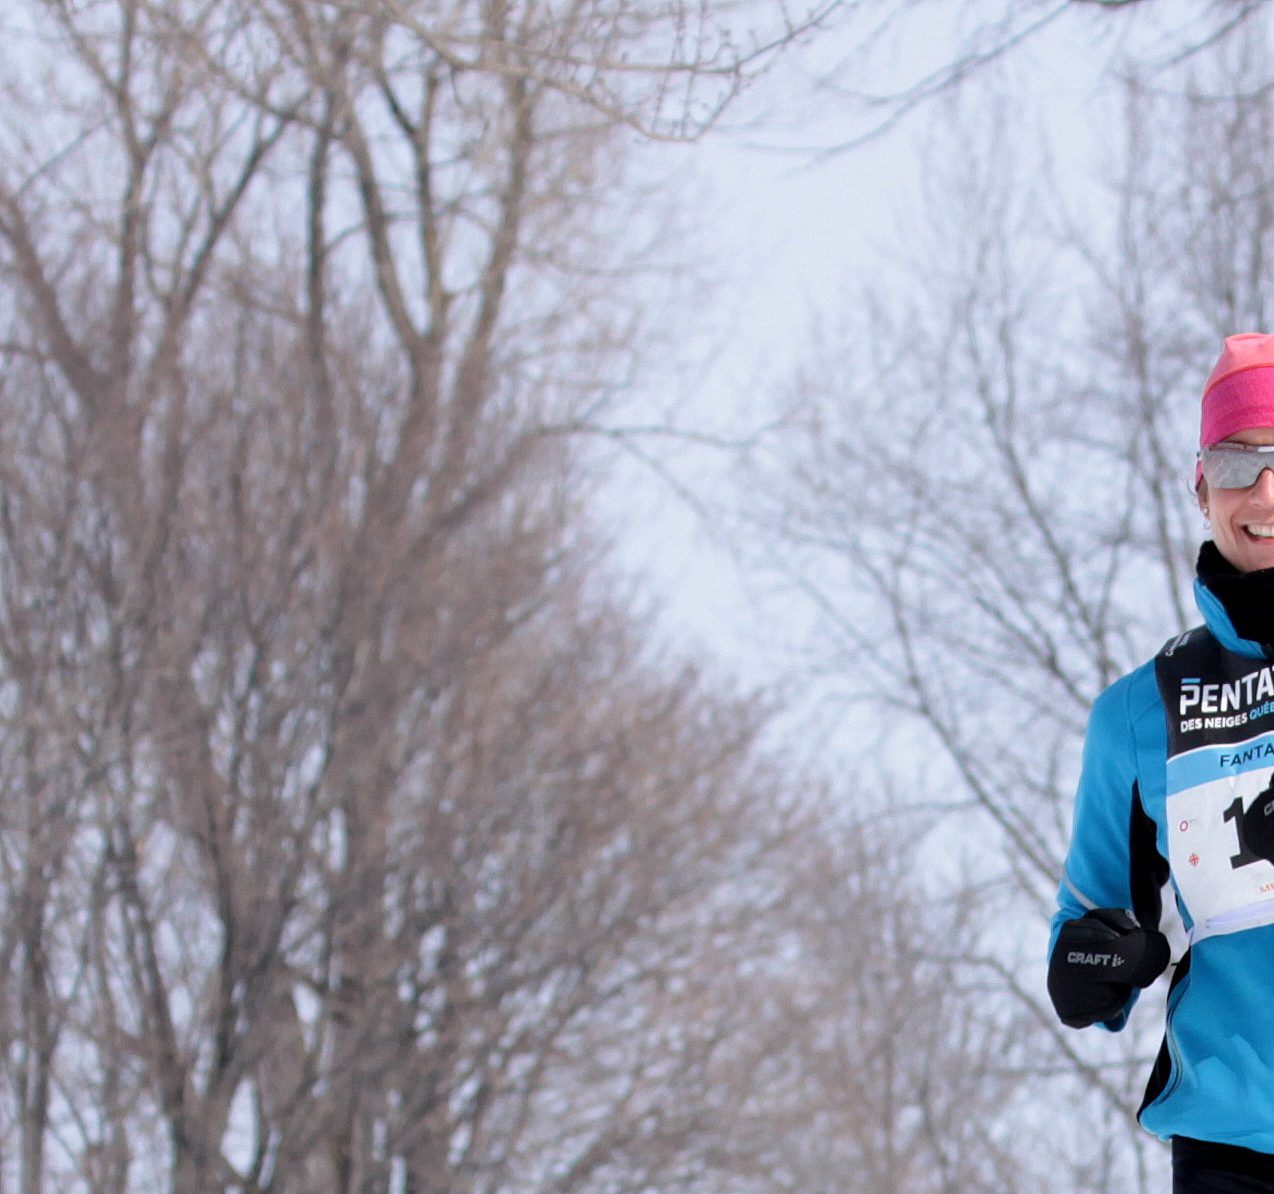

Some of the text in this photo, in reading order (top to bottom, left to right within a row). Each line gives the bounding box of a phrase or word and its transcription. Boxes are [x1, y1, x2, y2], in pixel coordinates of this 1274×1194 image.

[1180, 719, 1201, 732] DES
[1204, 713, 1248, 729] NEIGES
[1067, 951, 1111, 967] CRAFT
